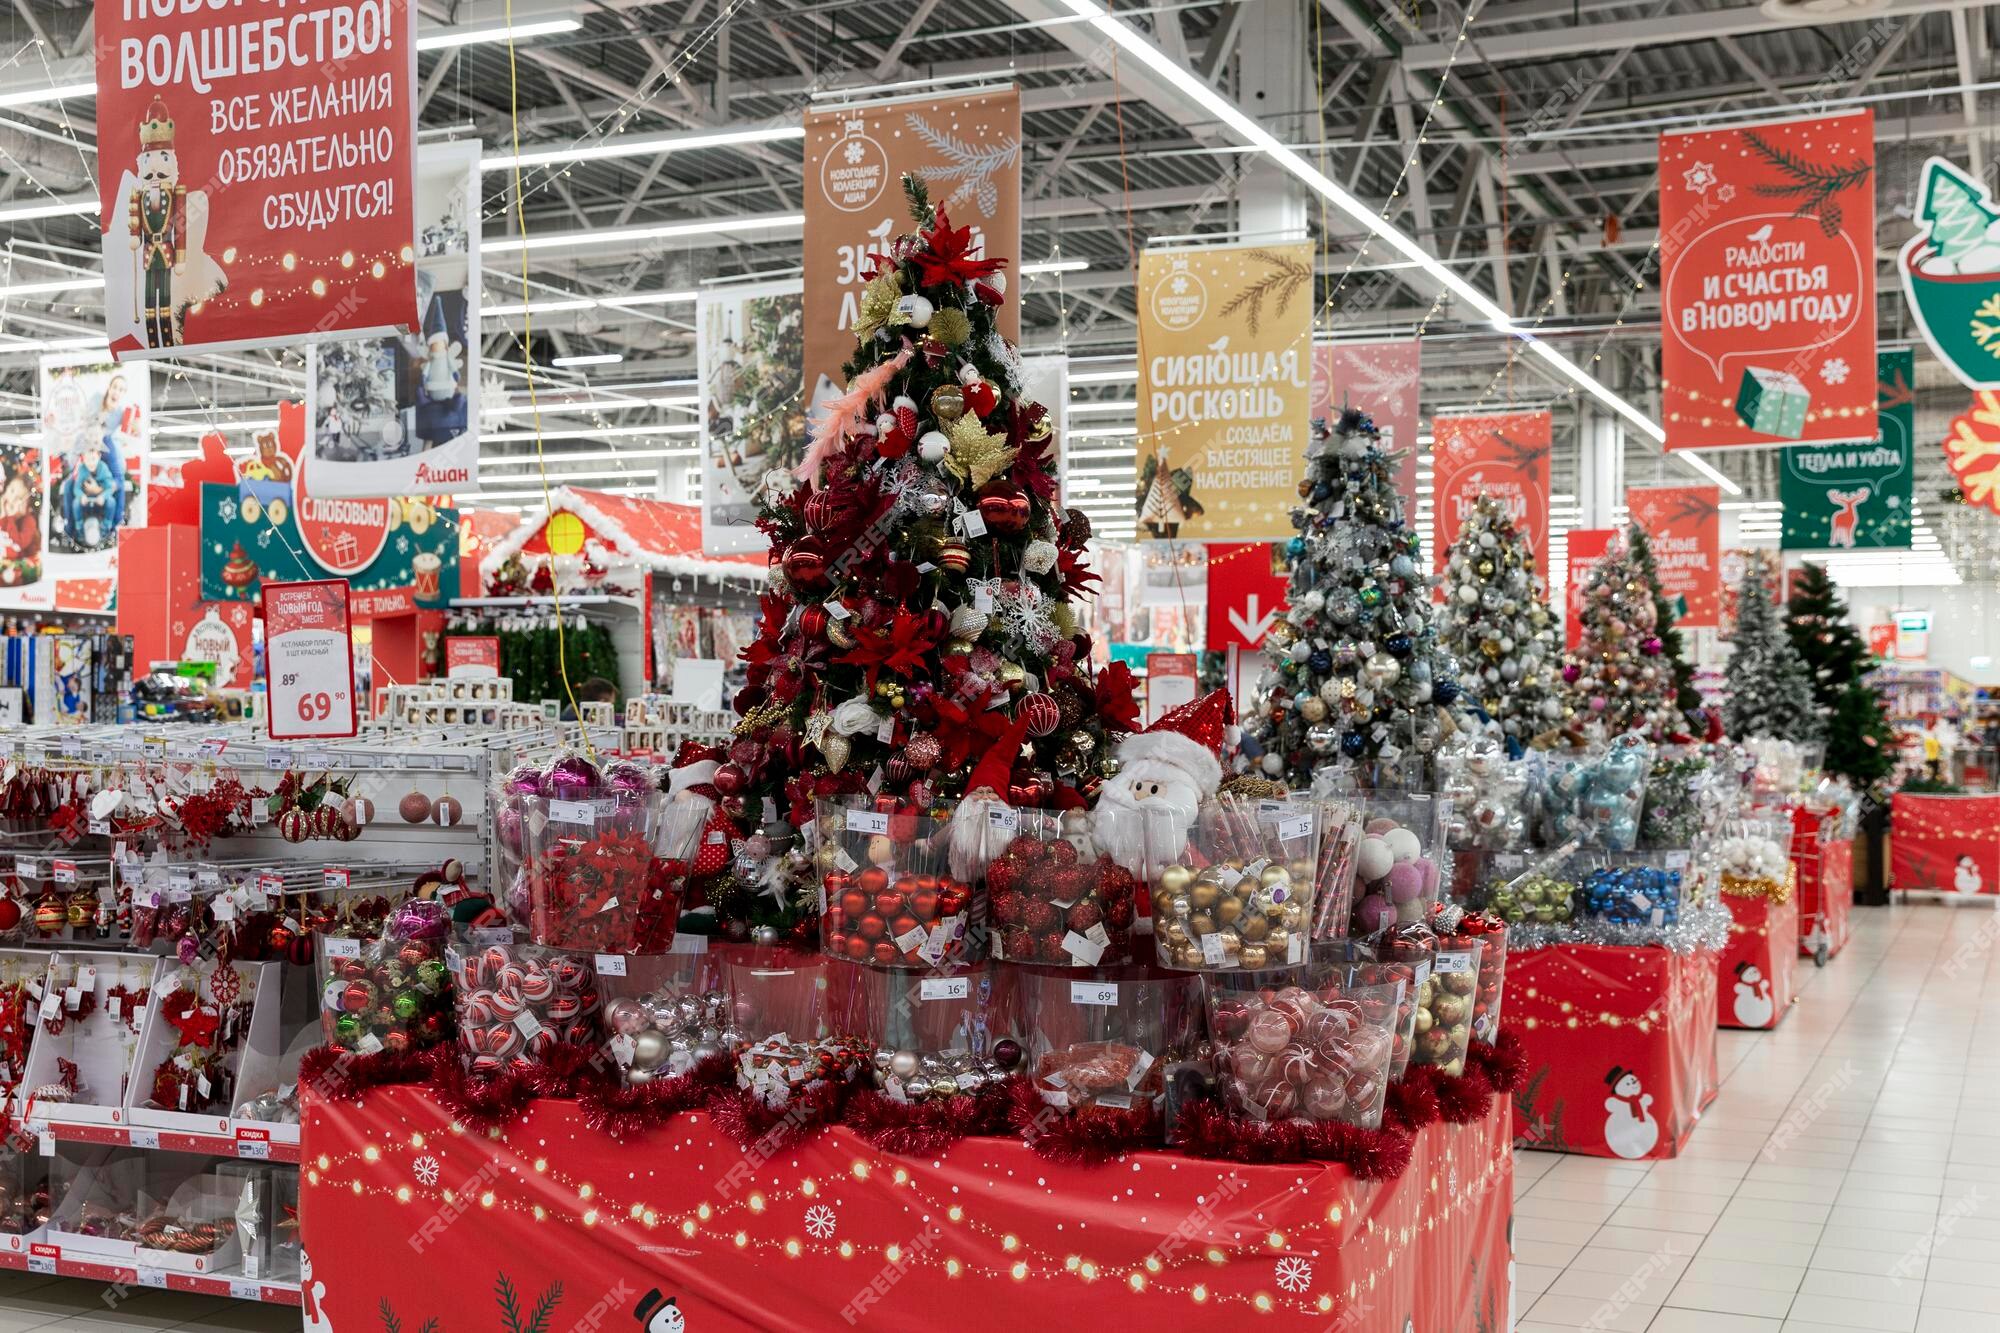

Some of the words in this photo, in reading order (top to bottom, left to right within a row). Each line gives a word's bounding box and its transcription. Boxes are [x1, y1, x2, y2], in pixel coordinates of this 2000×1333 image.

[120, 0, 393, 94] ВОЛШЕБСТВО!
[210, 94, 261, 135] ВСЕ
[268, 72, 392, 127] ЖЕЛАНИЯ
[218, 125, 393, 184] ОБЯЗАТЕЛЬНО
[830, 164, 881, 181] НОВОГОДНИЕ
[832, 177, 877, 192] КОЛЛЕКЦИИ
[263, 178, 393, 232] СБУДУТСЯ!
[843, 190, 867, 204] АШАН
[1725, 241, 1806, 268] РАДОСТИ
[1703, 275, 1721, 300] И
[1723, 265, 1828, 298] СЧАСТЬЯ
[1693, 300, 1787, 331] НОВОМ
[1790, 293, 1853, 324] ГОДУ
[1151, 350, 1307, 389] СИЯЮЩАЯ
[1151, 387, 1284, 423] РОСКОШЬ
[1207, 447, 1292, 468] БЛЕСТЯЩЕЕ
[1195, 469, 1293, 490] НАСТРОЕНИЕ!
[311, 498, 385, 528] ЛЮБОВЬЮ!
[276, 601, 307, 615] НОВЫЙ
[306, 600, 324, 614] ГОД
[301, 614, 325, 624] ВМЕСТЕ
[298, 691, 332, 722] 69
[335, 691, 346, 700] 90
[240, 1130, 264, 1140] СКИДКА
